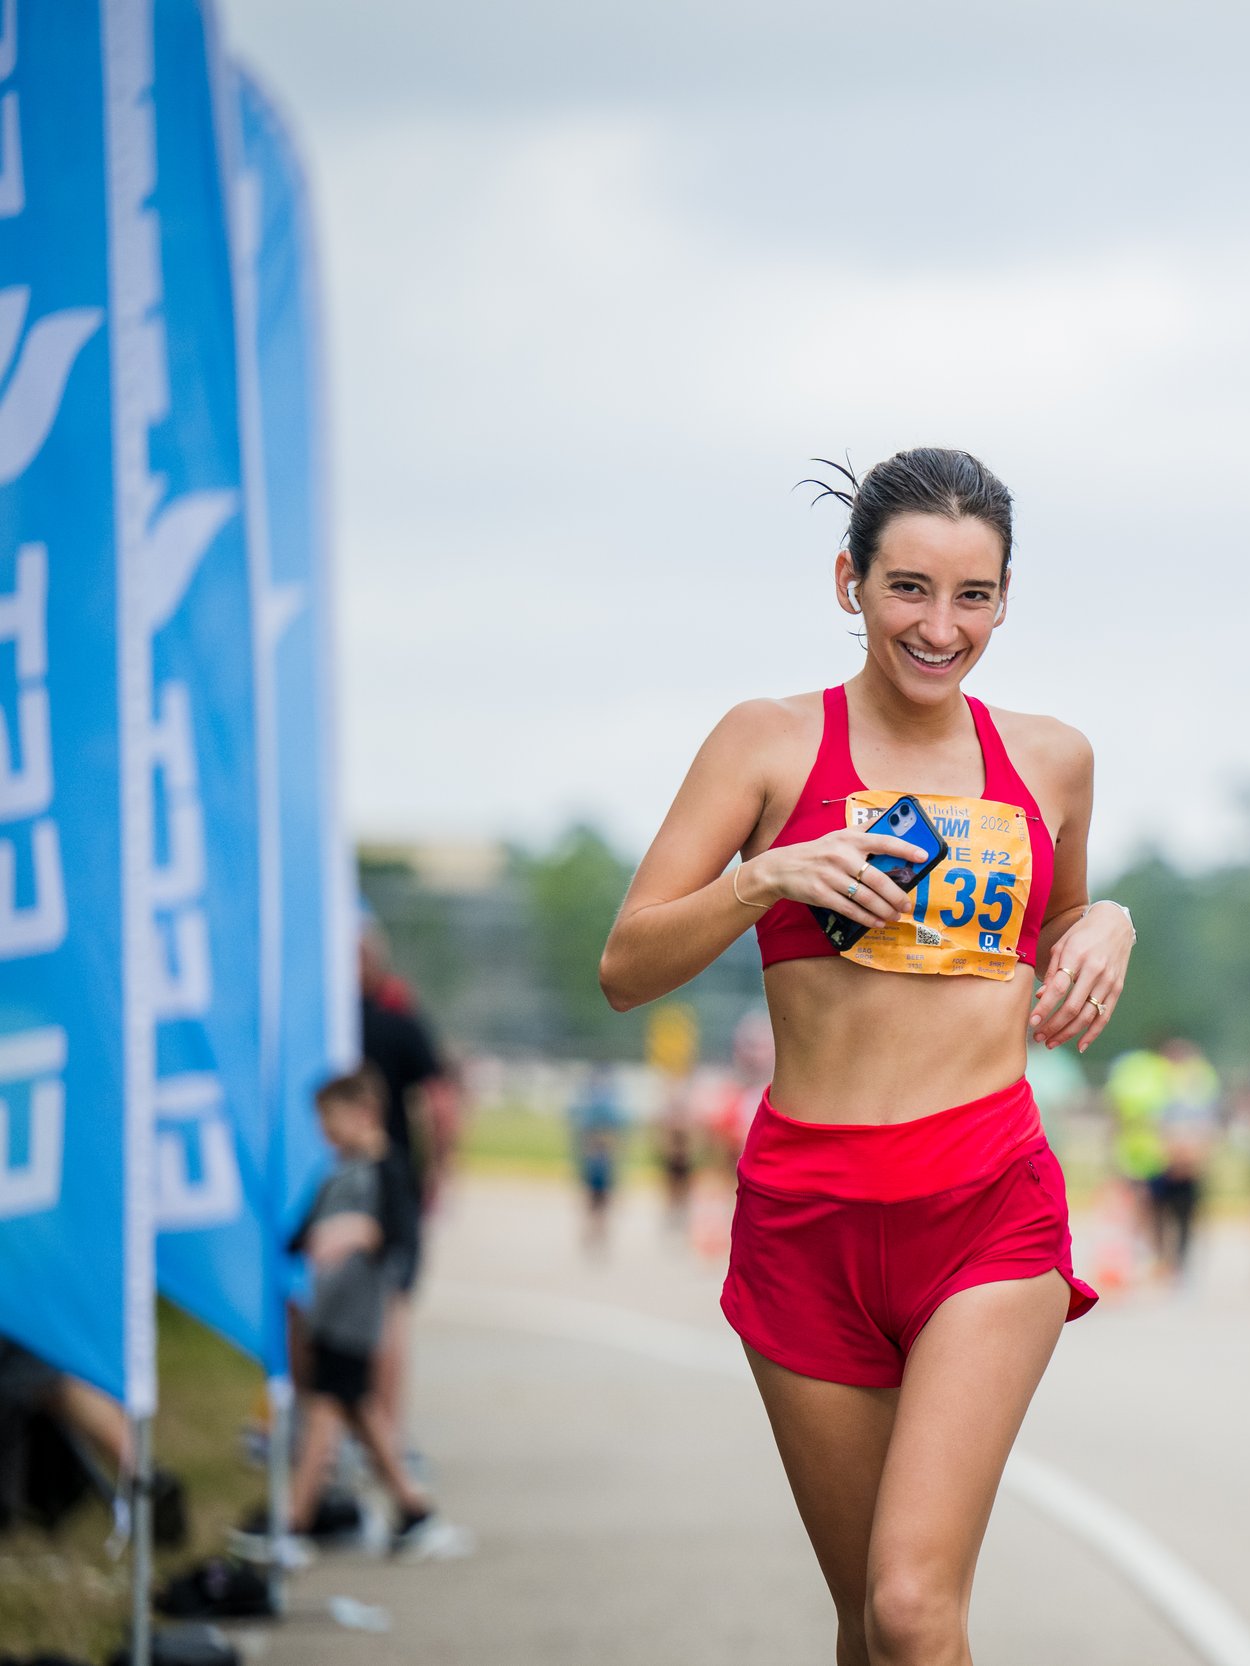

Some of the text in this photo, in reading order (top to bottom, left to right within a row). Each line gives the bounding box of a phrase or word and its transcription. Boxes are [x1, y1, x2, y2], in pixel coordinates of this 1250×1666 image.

[928, 804, 969, 818] thodist
[980, 815, 1010, 833] 2022
[980, 849, 1012, 866] #2
[913, 867, 1017, 931] 135
[984, 934, 994, 947] D
